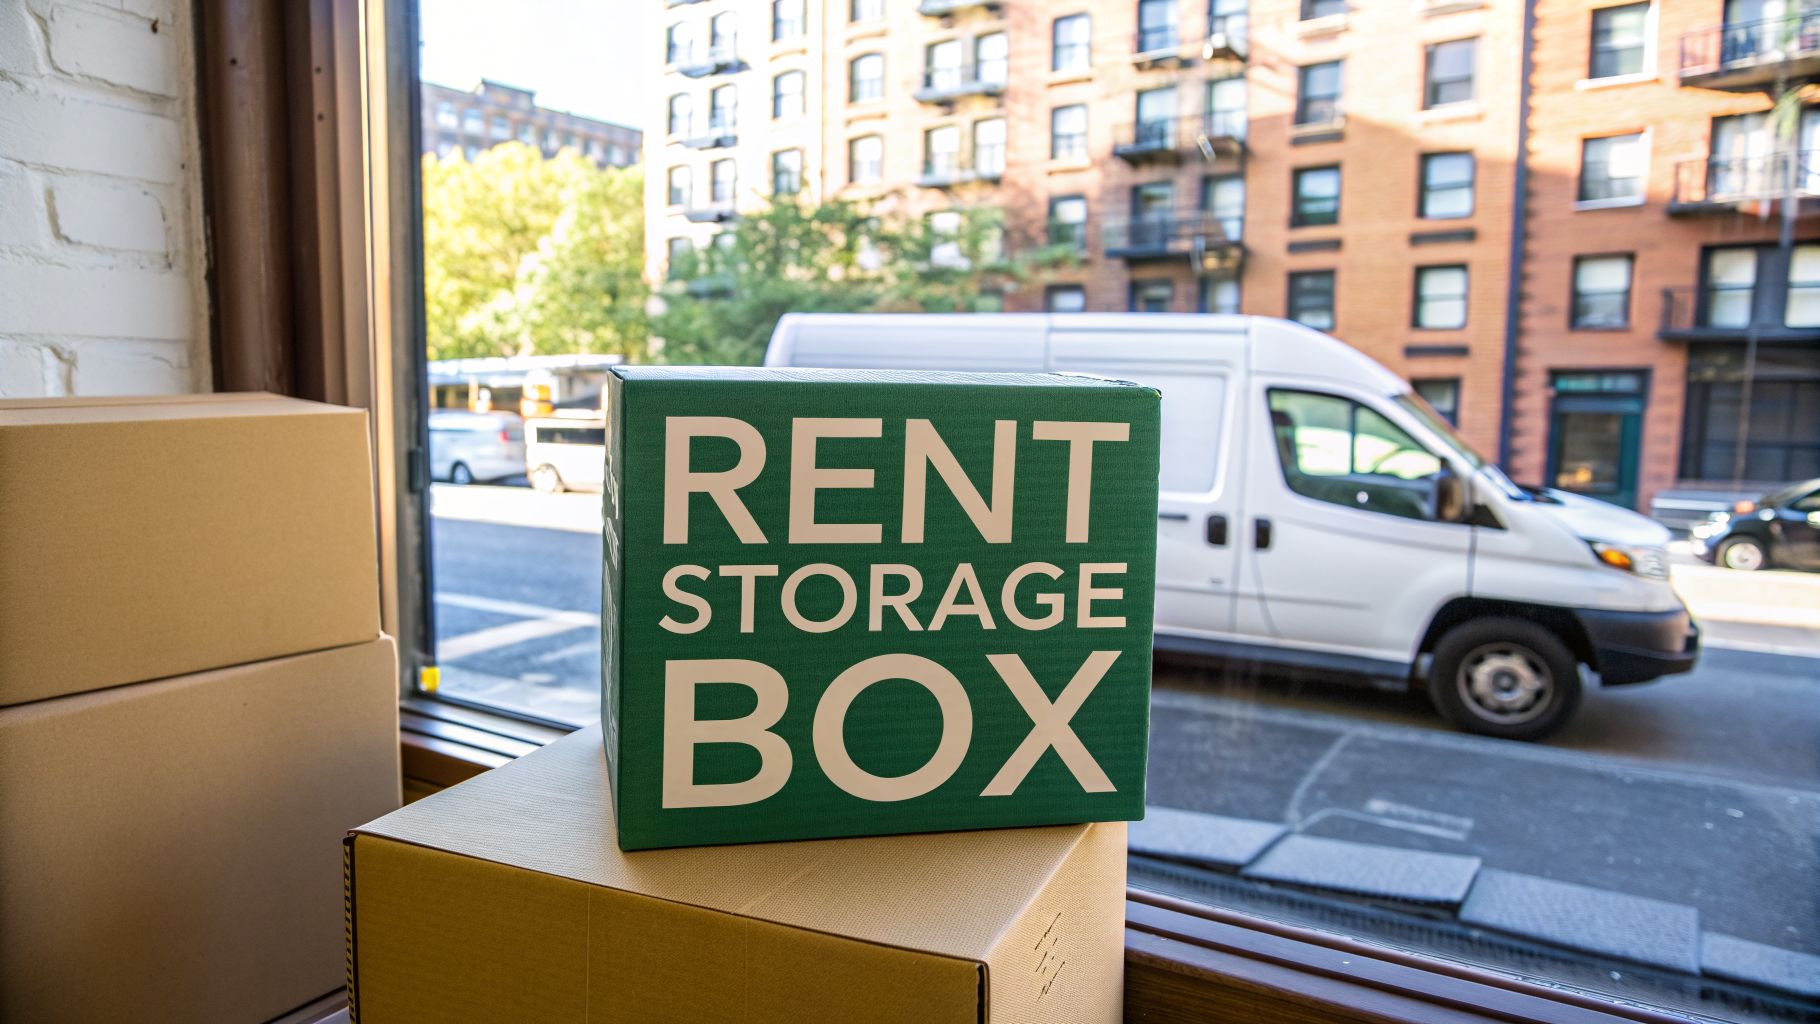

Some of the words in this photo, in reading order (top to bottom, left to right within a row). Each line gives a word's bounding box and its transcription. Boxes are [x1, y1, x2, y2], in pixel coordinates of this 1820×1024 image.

[662, 416, 1131, 545] RENT
[658, 562, 1128, 635] STORAGE
[661, 650, 1123, 809] BOX
